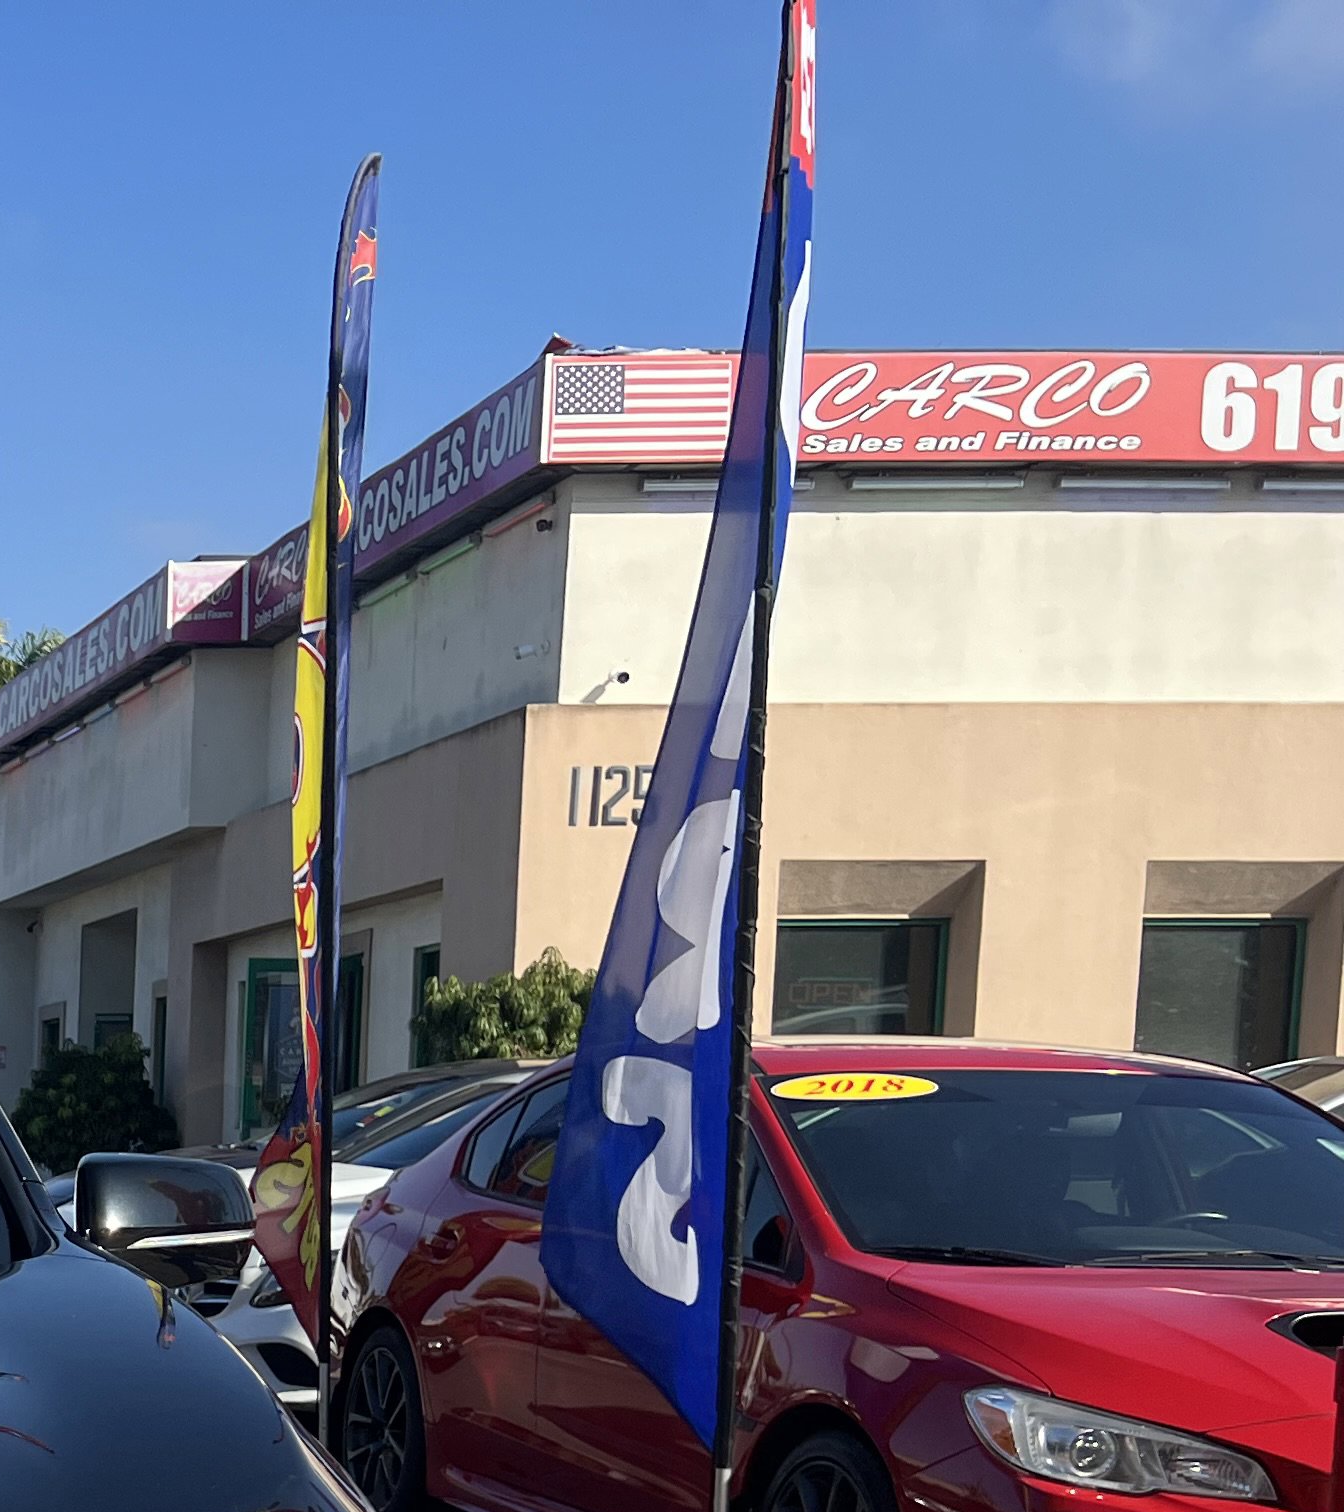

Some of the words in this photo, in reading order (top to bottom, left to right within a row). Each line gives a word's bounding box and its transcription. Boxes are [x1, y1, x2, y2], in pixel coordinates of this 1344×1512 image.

[801, 360, 1151, 431] CARCO
[1199, 362, 1344, 452] 619
[802, 433, 903, 454] Sales
[915, 431, 982, 452] and
[994, 430, 1142, 452] Finance
[354, 376, 537, 556] COSALES.COM
[255, 529, 308, 605] CARC
[804, 1078, 905, 1096] 2018
